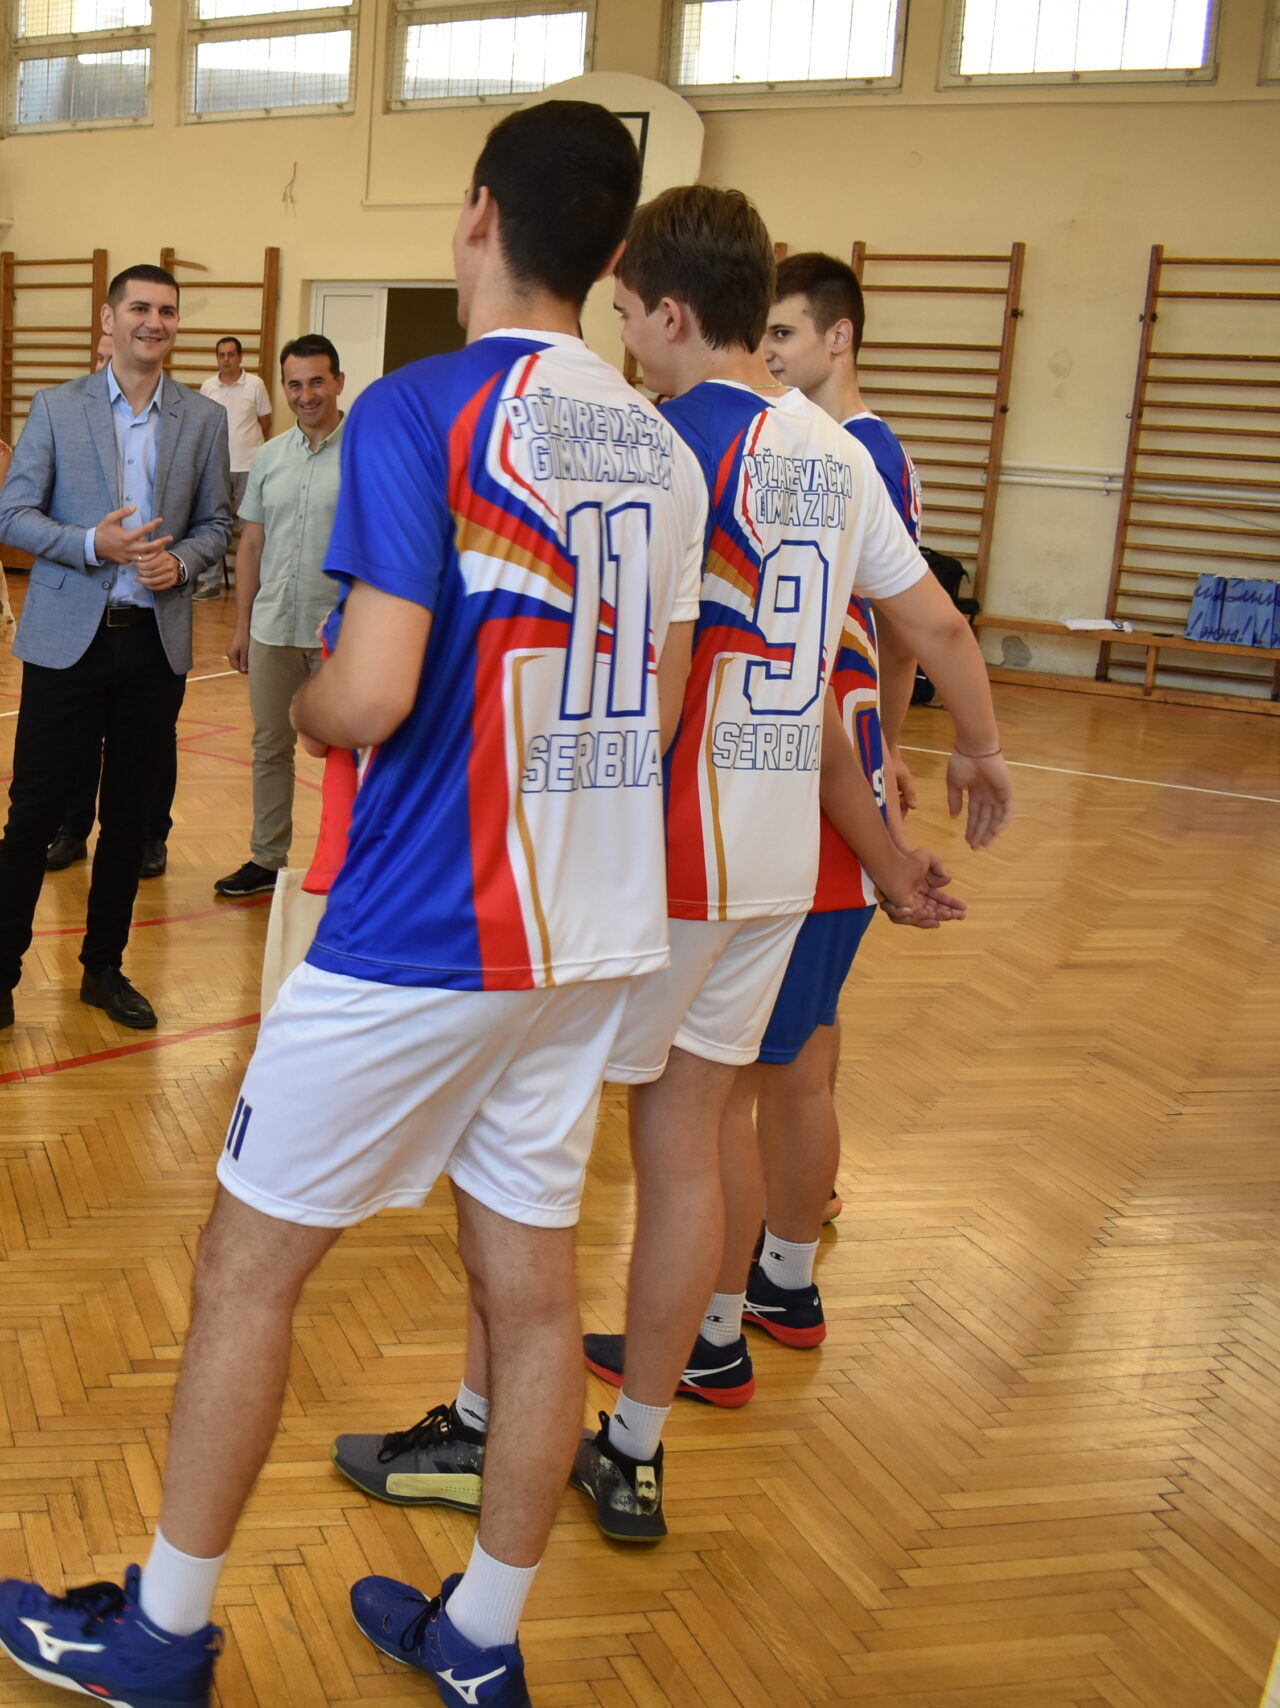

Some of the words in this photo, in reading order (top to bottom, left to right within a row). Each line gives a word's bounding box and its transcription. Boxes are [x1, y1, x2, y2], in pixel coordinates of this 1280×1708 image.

[559, 501, 652, 721] 11
[742, 539, 829, 716] 9
[520, 729, 663, 793] SERBIA
[711, 721, 820, 771] SERBIA
[226, 1095, 253, 1162] 11
